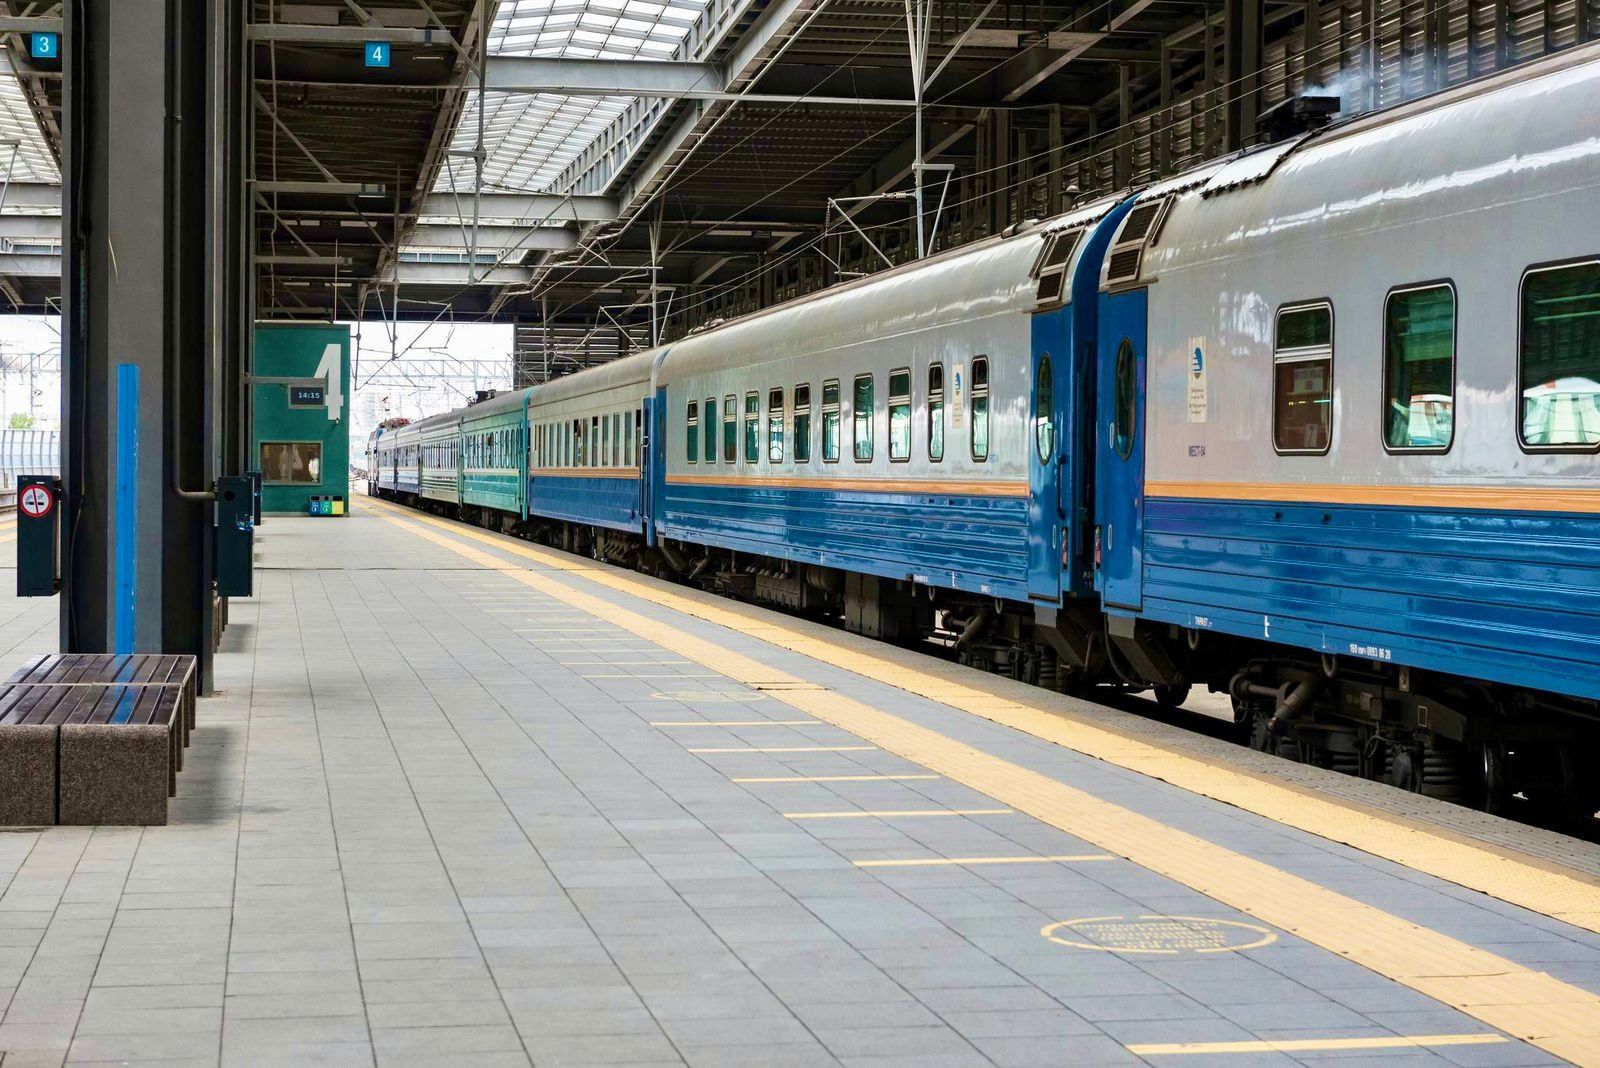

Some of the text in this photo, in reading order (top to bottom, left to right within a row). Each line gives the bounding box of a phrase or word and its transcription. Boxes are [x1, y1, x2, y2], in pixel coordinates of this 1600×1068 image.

[40, 36, 49, 53] 3
[372, 45, 383, 62] 4
[313, 343, 344, 420] 4
[297, 391, 321, 399] 14:15
